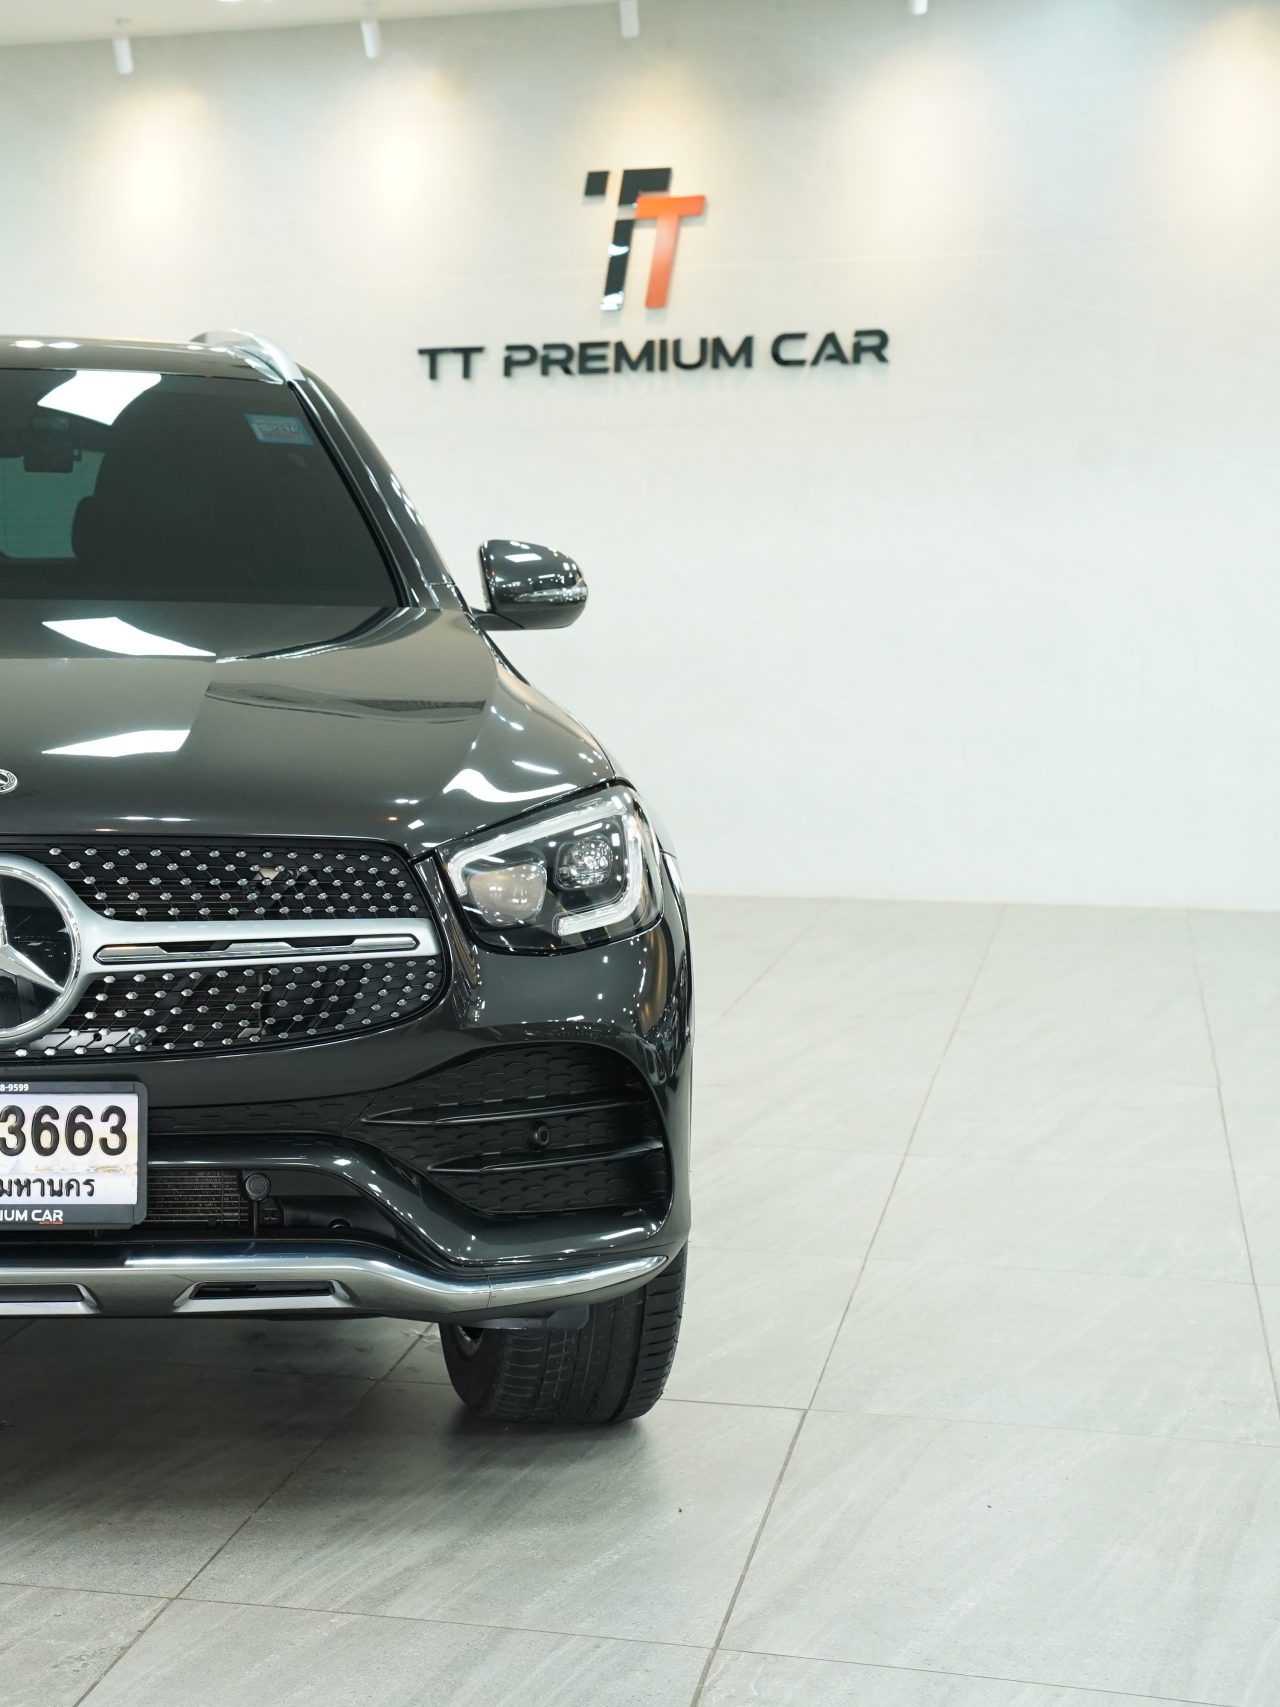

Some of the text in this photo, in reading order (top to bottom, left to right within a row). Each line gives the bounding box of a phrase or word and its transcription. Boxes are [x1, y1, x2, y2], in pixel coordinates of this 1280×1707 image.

[418, 329, 889, 380] TT PREMIUM CAR
[30, 1209, 64, 1222] CAR
